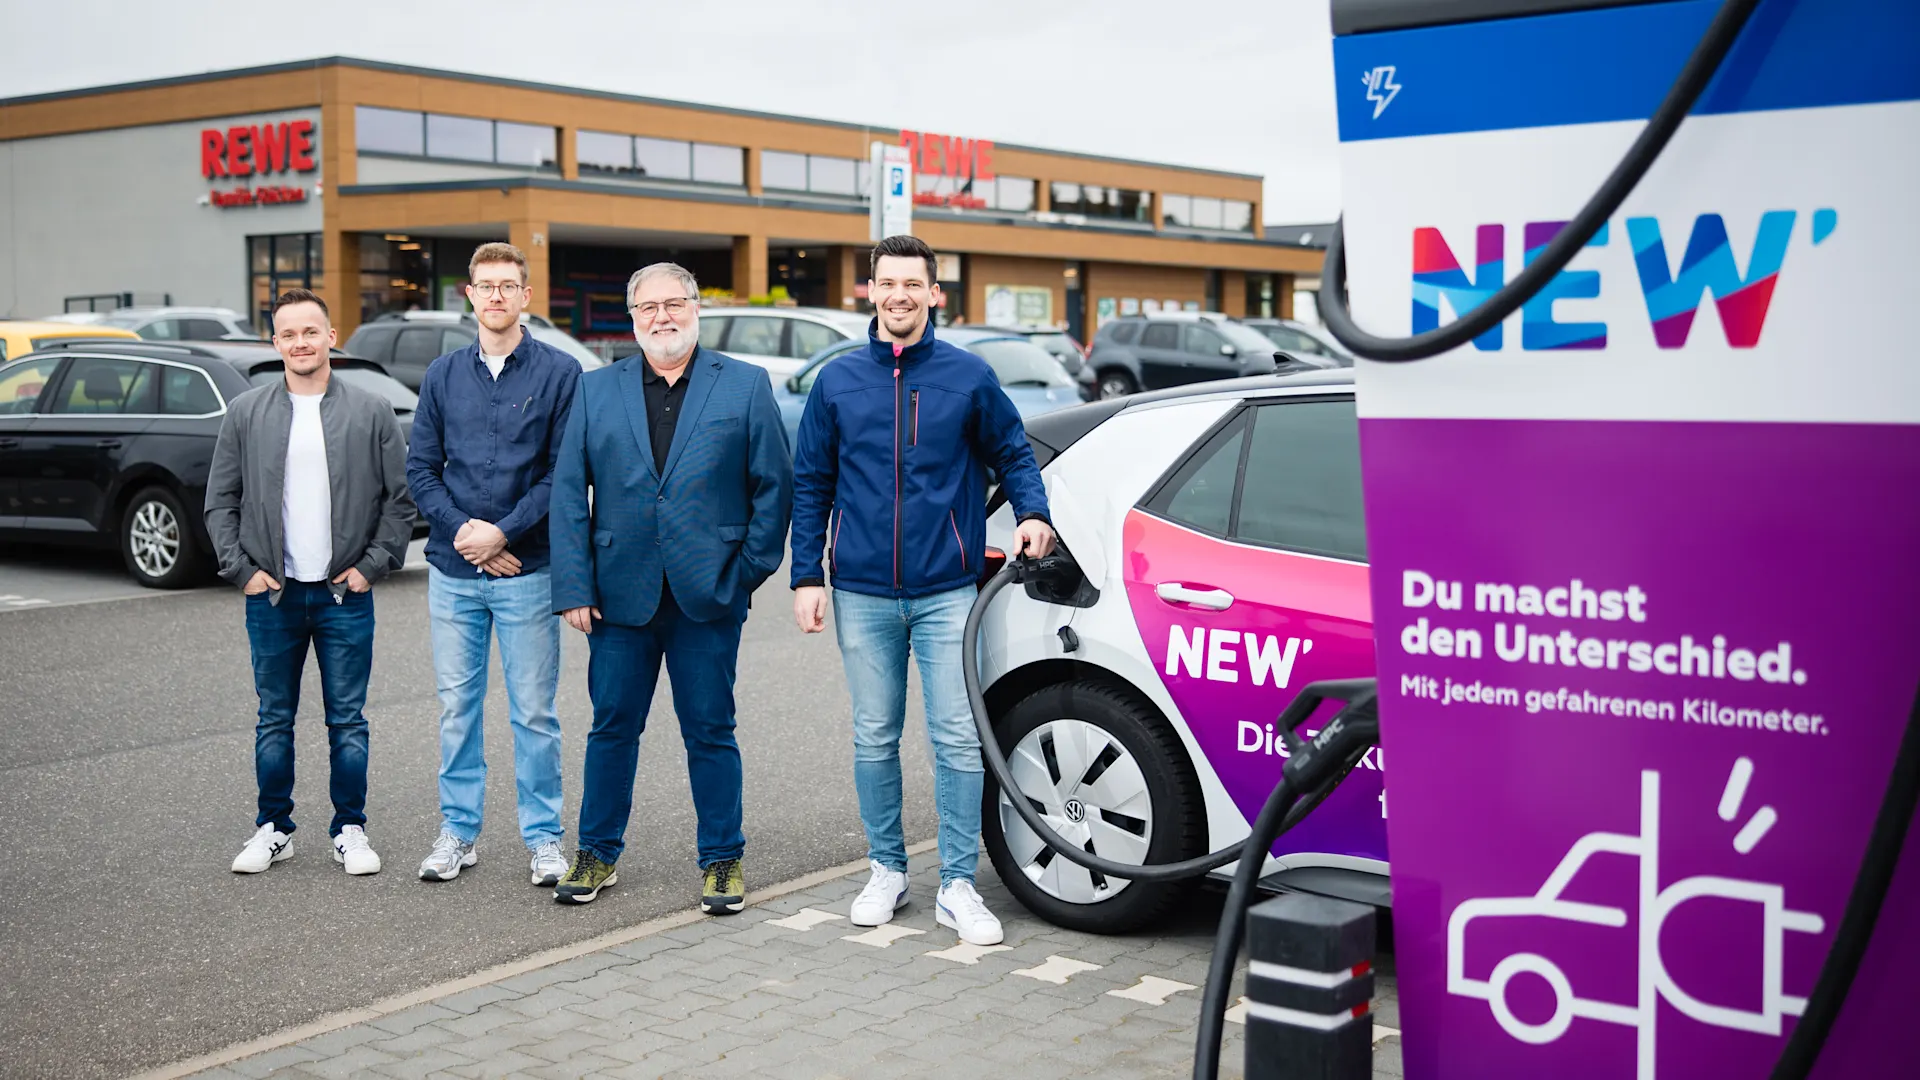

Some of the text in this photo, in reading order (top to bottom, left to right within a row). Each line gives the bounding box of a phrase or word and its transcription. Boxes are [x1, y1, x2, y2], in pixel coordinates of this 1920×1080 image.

[201, 120, 313, 177] REWE
[1039, 560, 1055, 569] HPC
[1402, 570, 1647, 622] Du machst
[1400, 617, 1808, 685] den Unterschied.
[1400, 673, 1830, 736] Mit jedem gefahrenen Kilometer.
[1313, 717, 1345, 751] HPC
